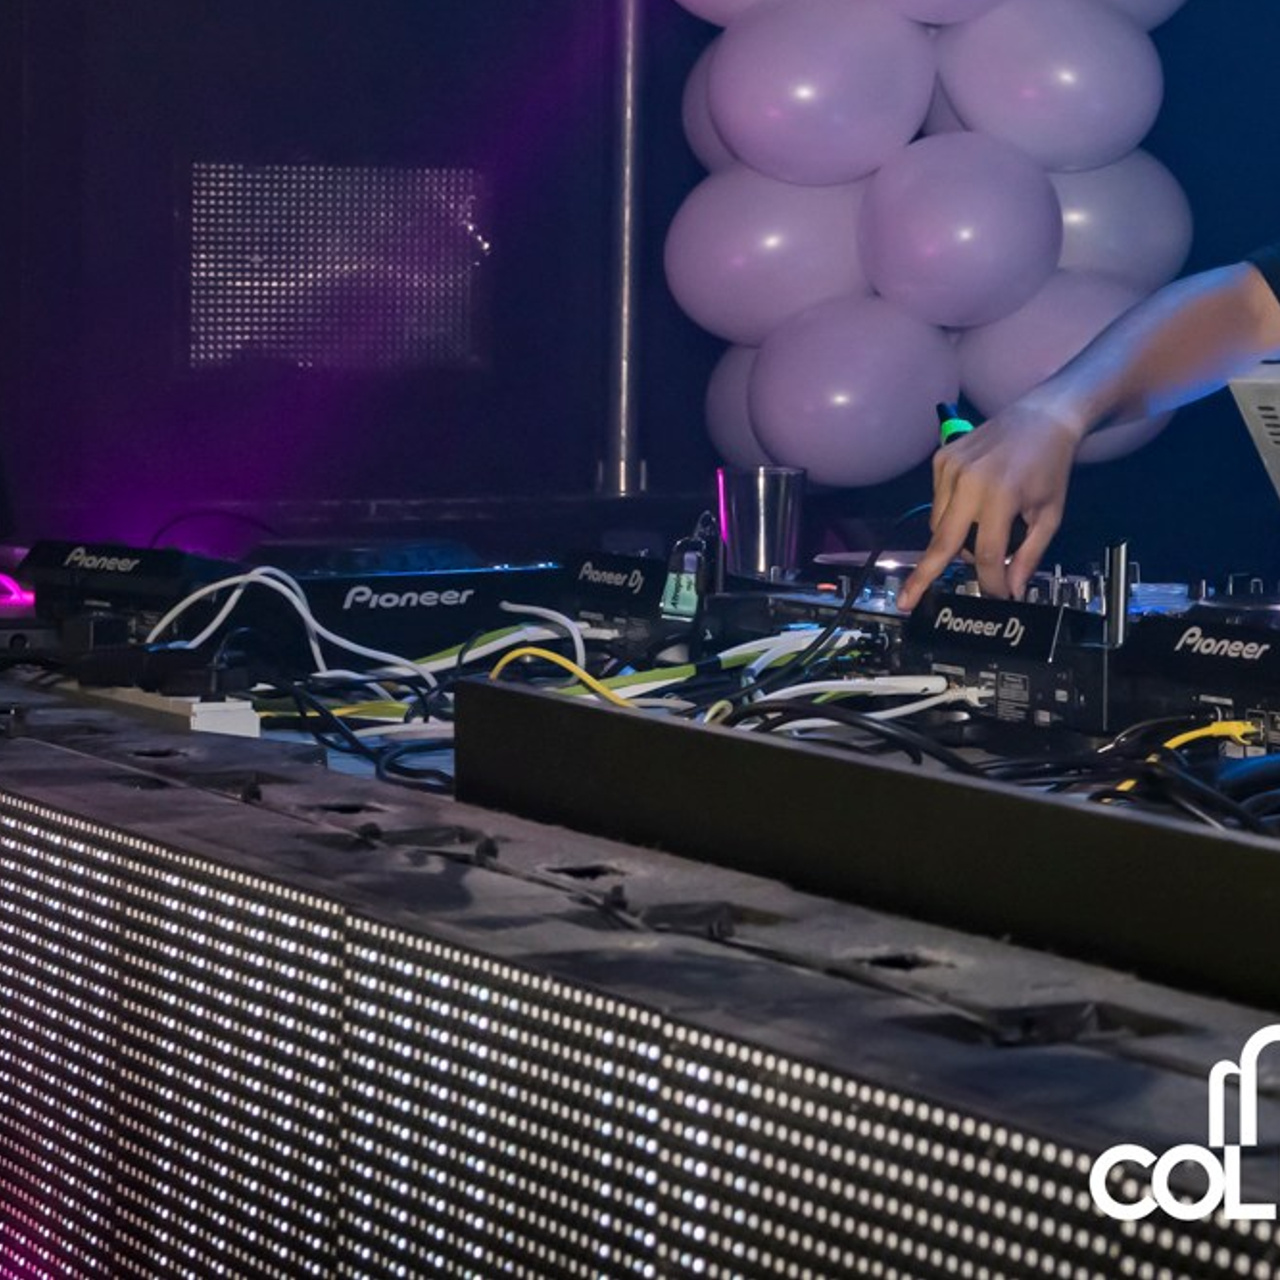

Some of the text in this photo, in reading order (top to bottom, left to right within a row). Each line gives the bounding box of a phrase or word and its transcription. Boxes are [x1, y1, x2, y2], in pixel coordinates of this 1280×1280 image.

[63, 546, 141, 572] Pioneer
[578, 561, 628, 587] Pioneer
[342, 585, 475, 610] Pioneer
[933, 607, 1002, 636] Pioneer
[1174, 625, 1271, 660] Pioneer
